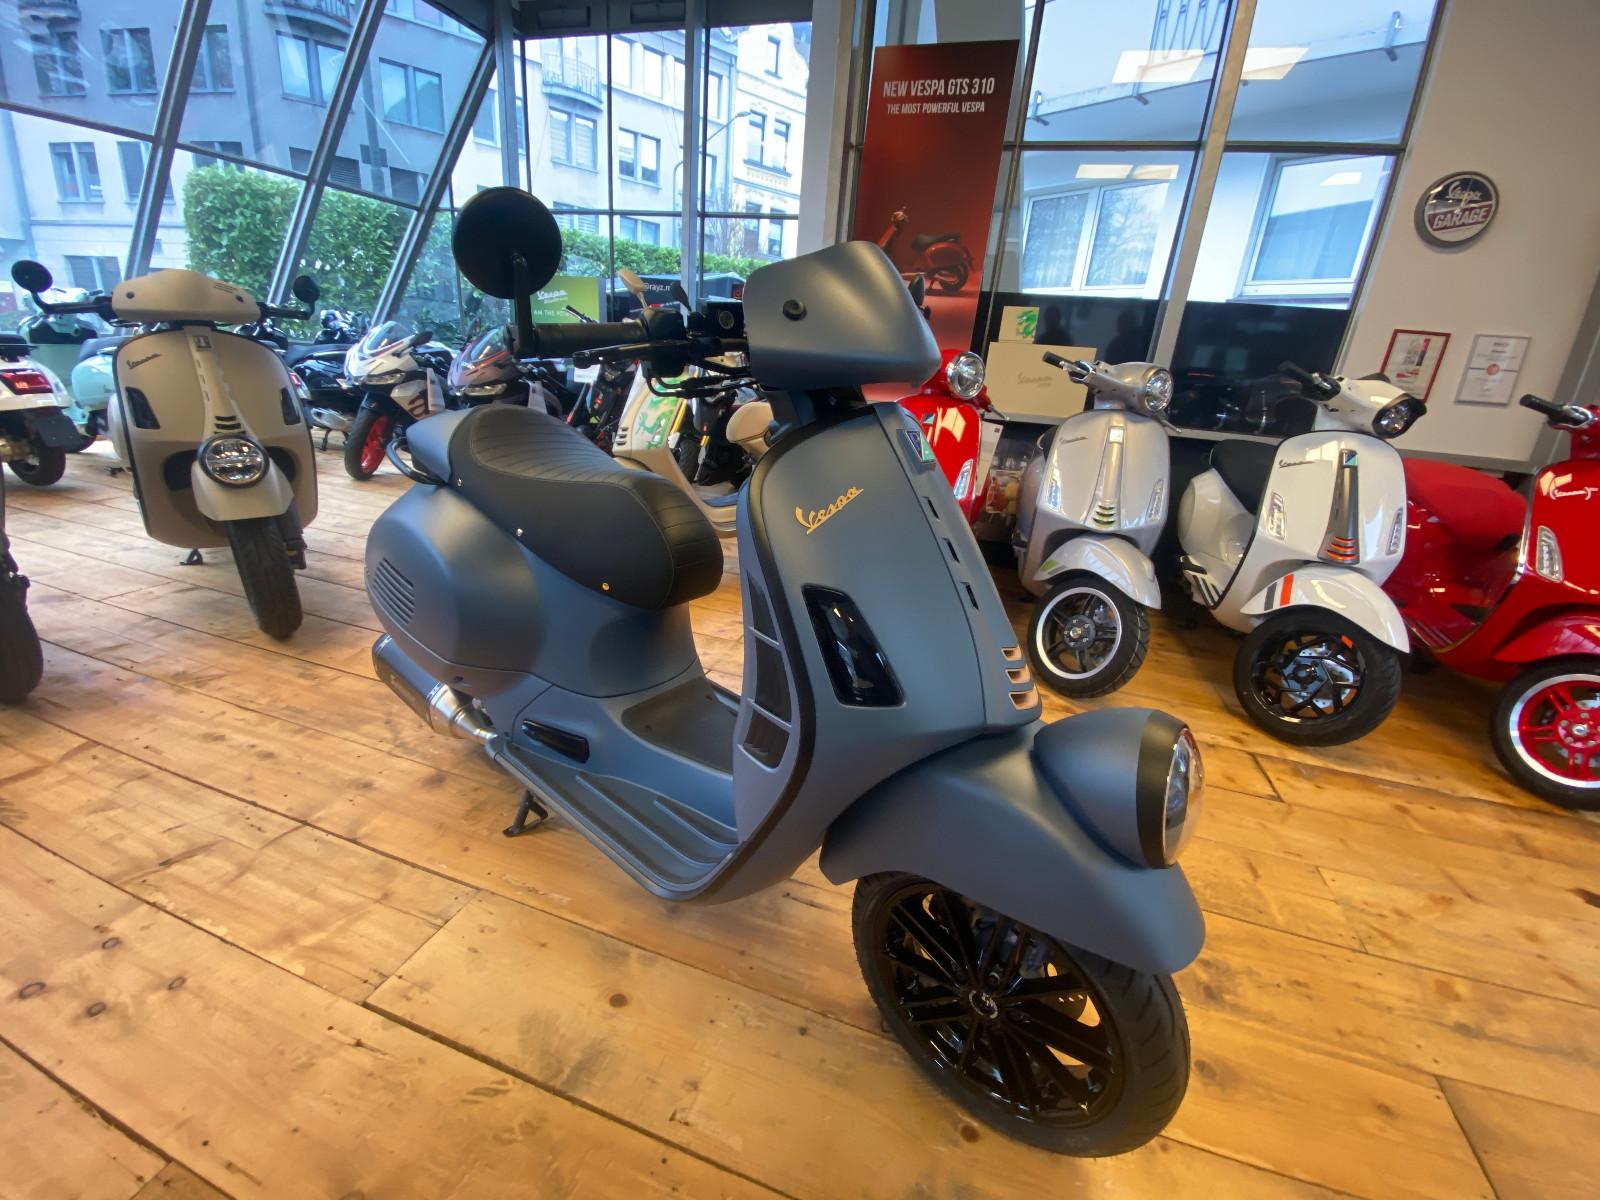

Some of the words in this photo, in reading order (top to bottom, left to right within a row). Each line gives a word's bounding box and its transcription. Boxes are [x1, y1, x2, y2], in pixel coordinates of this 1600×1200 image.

[883, 80, 908, 97] NEW
[910, 79, 945, 96] VESPA
[947, 78, 970, 96] GTS
[971, 77, 995, 95] 310
[887, 103, 900, 115] THE
[901, 103, 921, 114] MOST
[922, 102, 960, 113] POWERFUL
[961, 102, 985, 113] VESPA
[1433, 208, 1488, 229] GARAGE
[795, 486, 864, 535] Vespa
